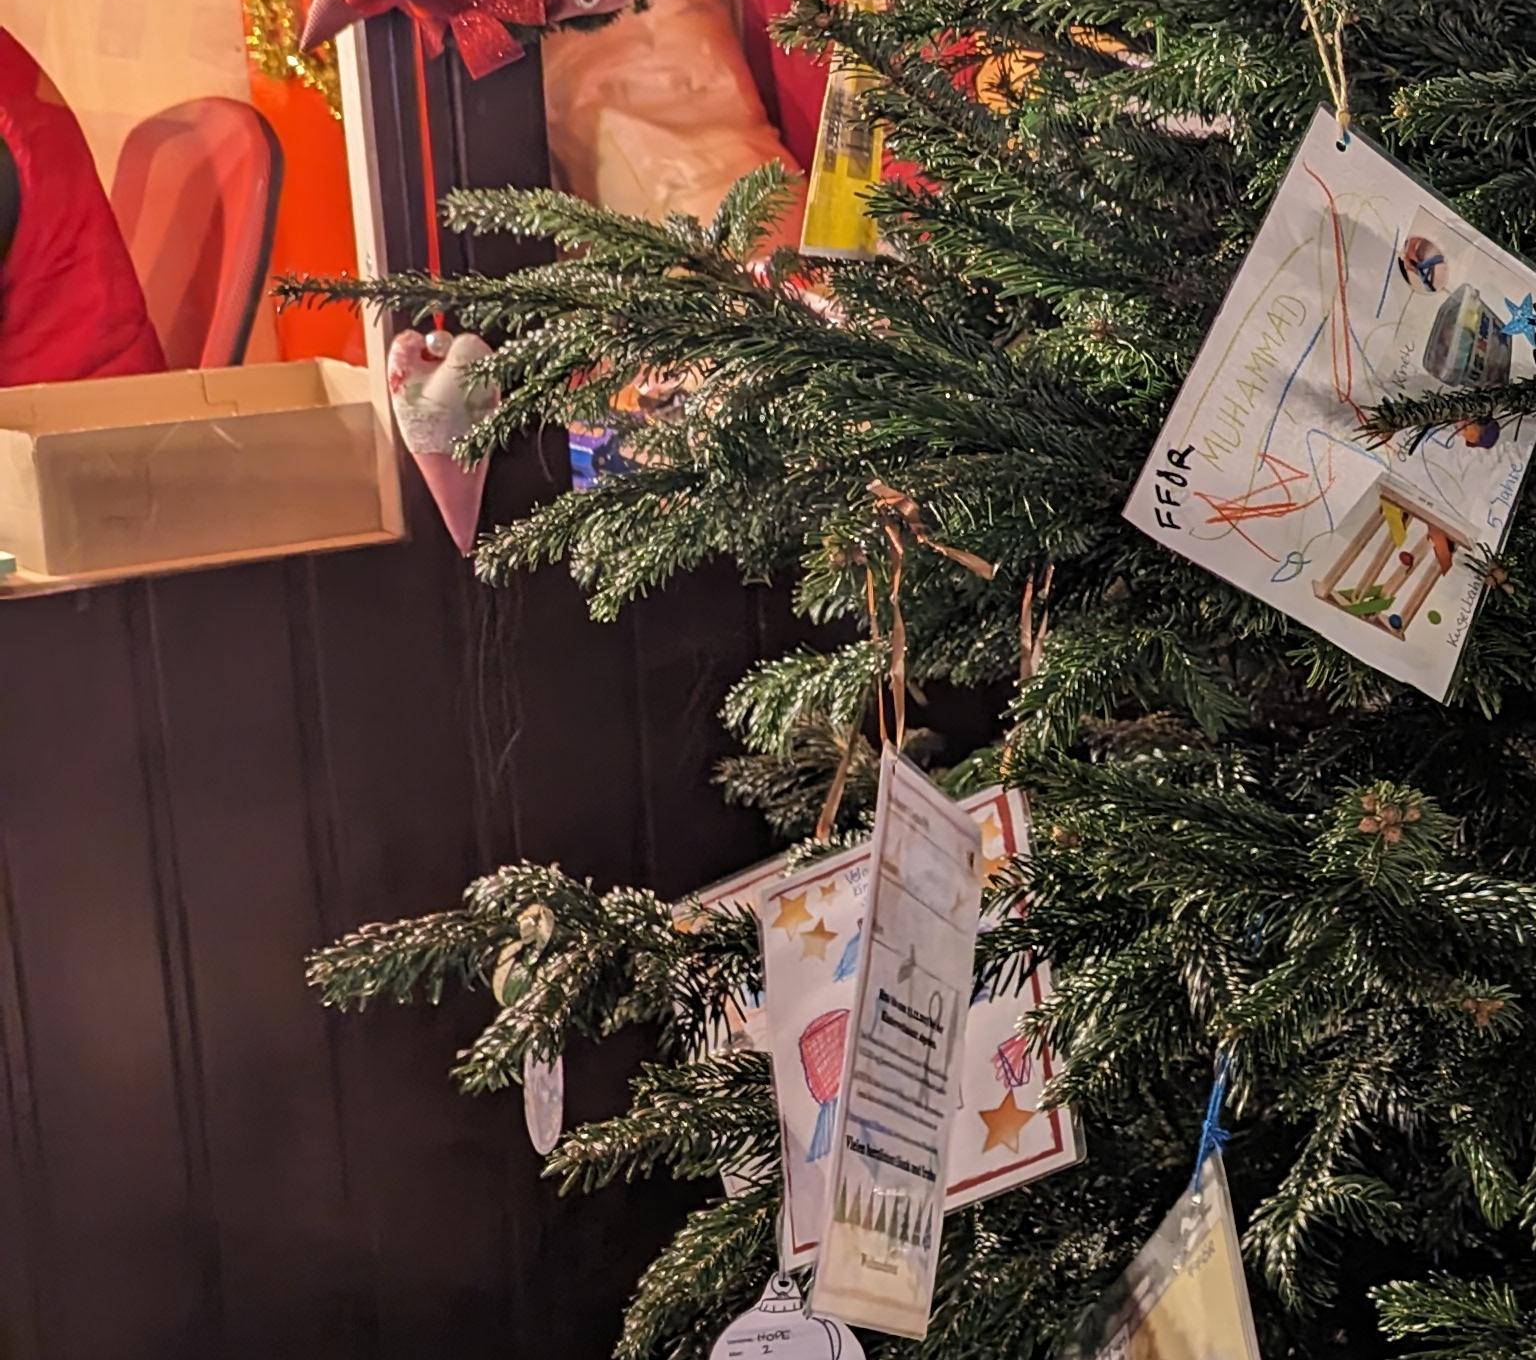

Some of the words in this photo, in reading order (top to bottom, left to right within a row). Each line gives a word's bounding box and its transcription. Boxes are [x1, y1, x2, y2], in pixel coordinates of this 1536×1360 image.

[1202, 295, 1309, 472] MUHAMMAD
[1486, 509, 1504, 529] 5
[757, 1330, 791, 1341] HOPE
[762, 1344, 774, 1354] 2
